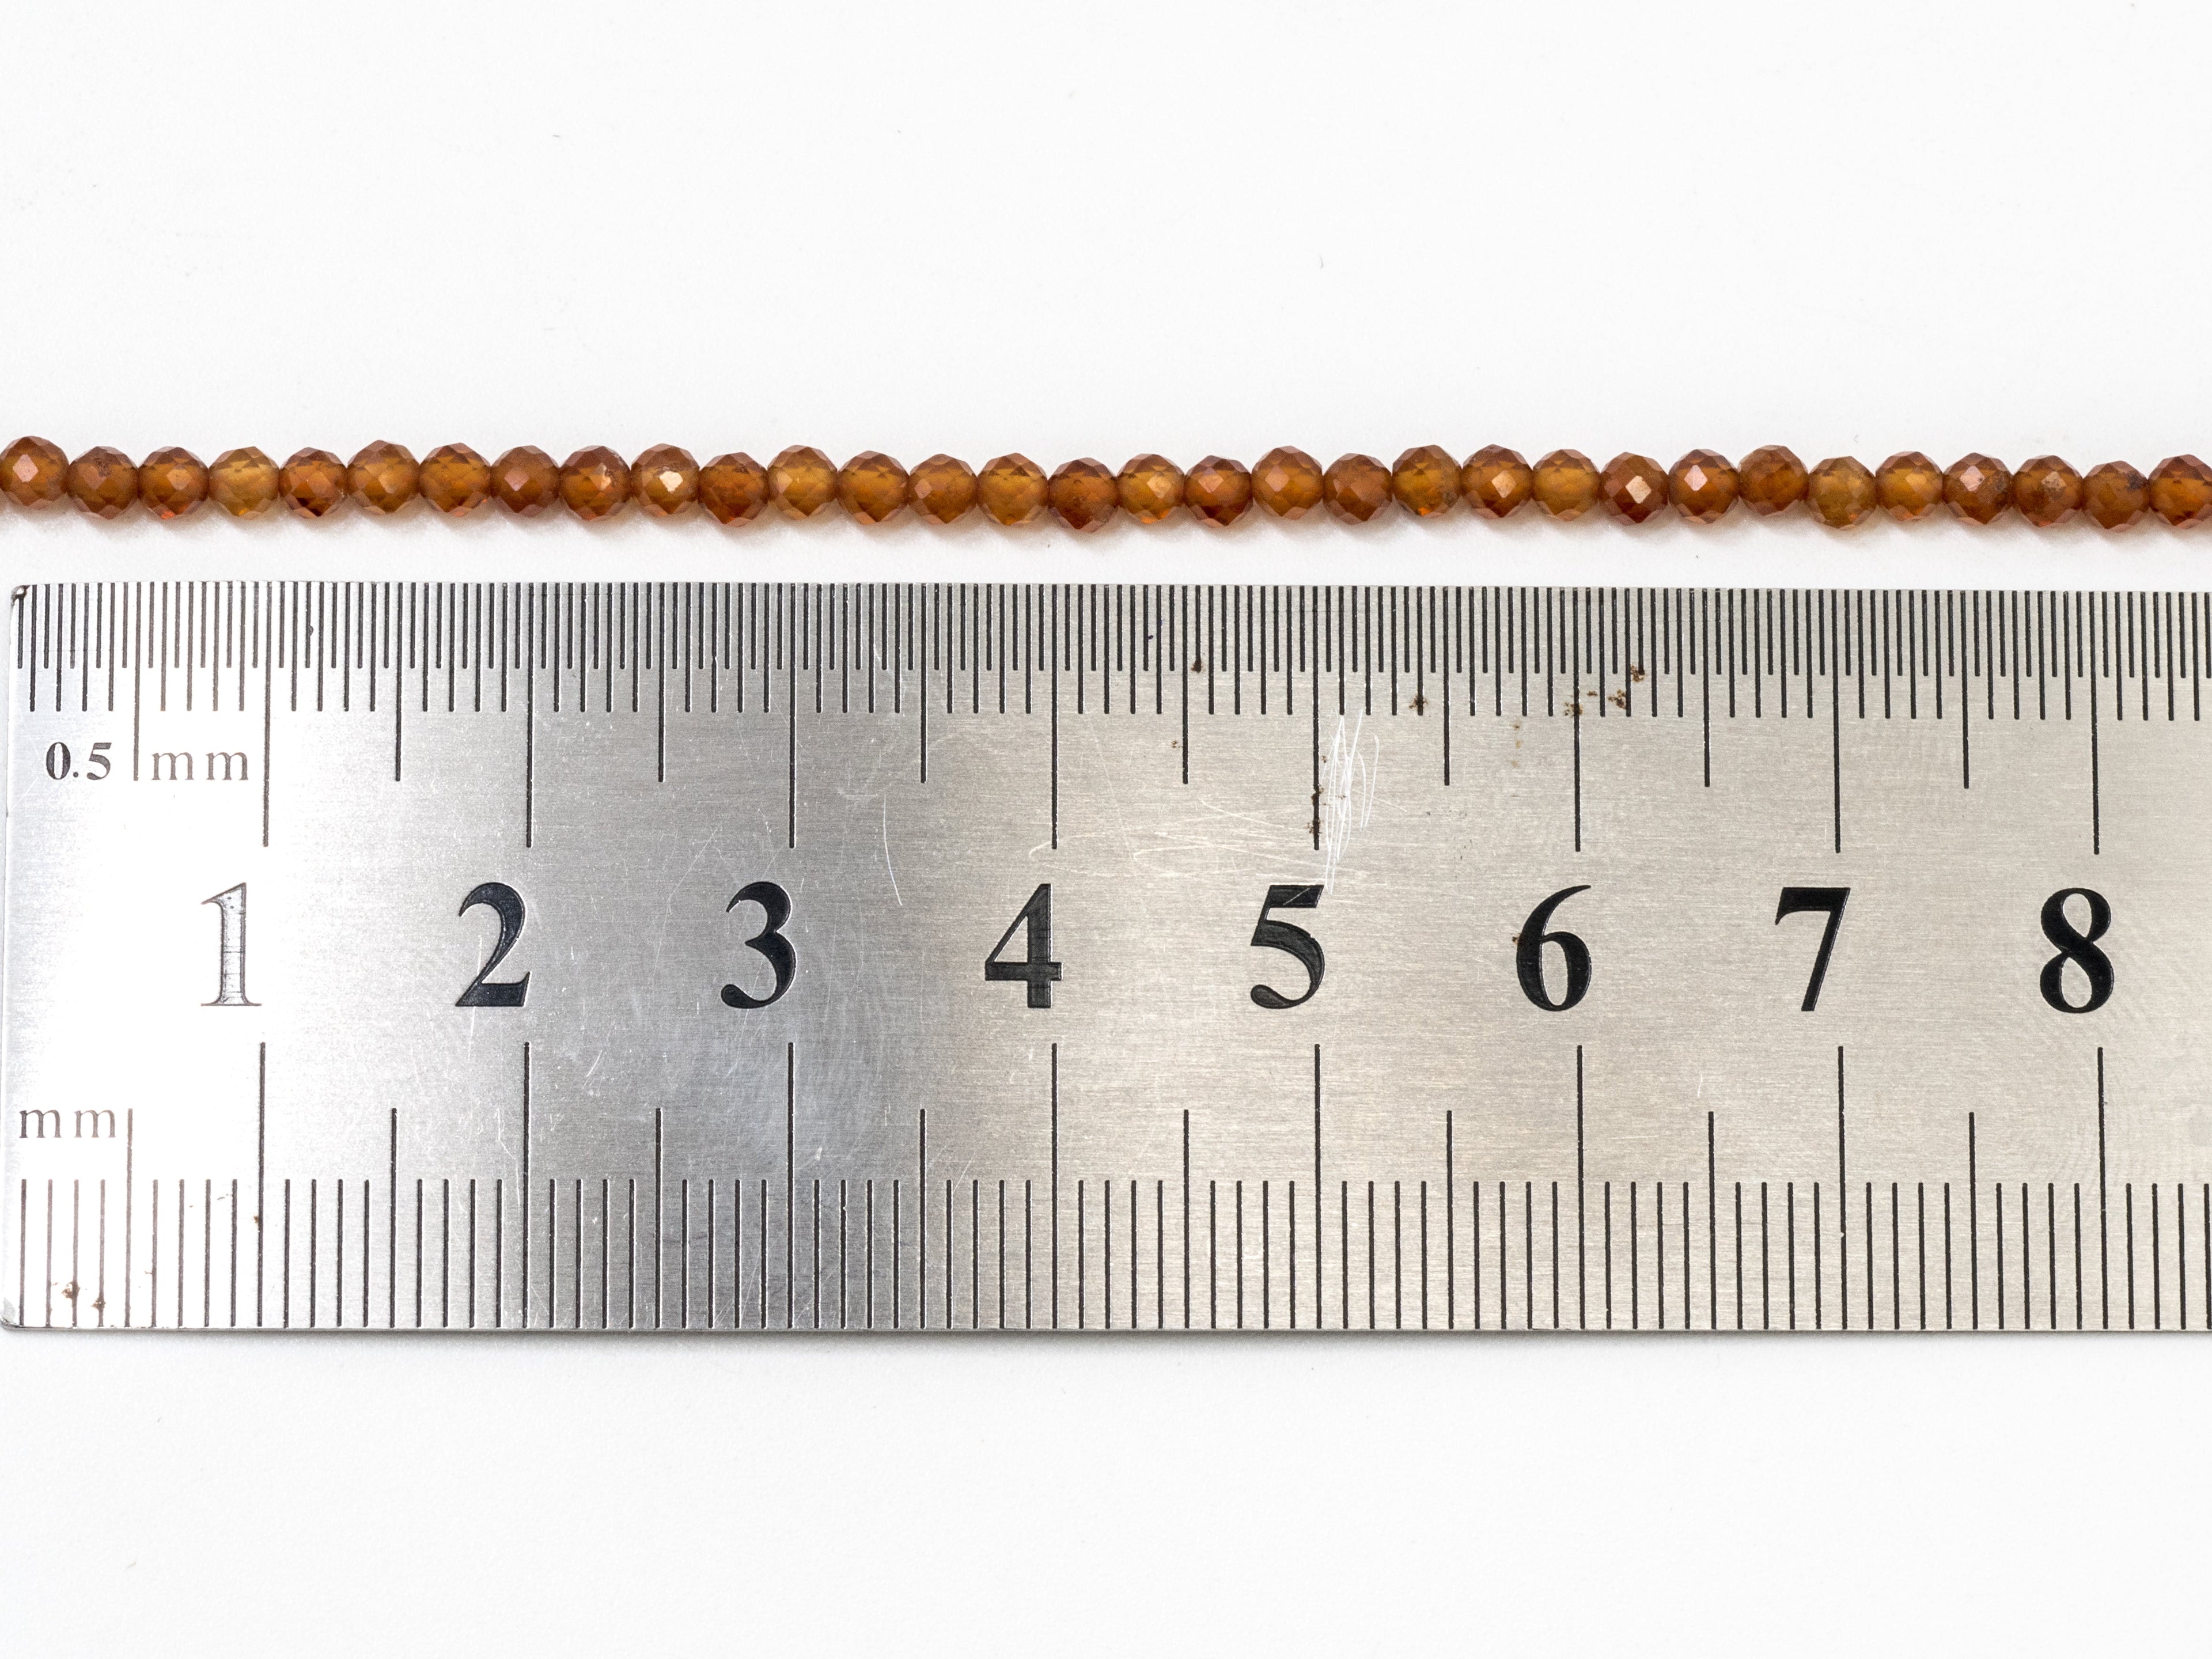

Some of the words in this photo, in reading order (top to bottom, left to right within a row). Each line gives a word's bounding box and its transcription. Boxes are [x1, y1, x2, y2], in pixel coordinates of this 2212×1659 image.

[46, 741, 112, 781] 0.5
[151, 752, 249, 781] mm
[200, 882, 262, 1006] 1
[454, 882, 530, 1008] 2
[721, 881, 796, 1009] 3
[984, 883, 1062, 1009] 4
[1250, 884, 1325, 1010] 5
[1514, 885, 1592, 1012] 6
[1775, 887, 1851, 1012] 7
[2040, 888, 2115, 1014] 8
[18, 1109, 116, 1139] mm
